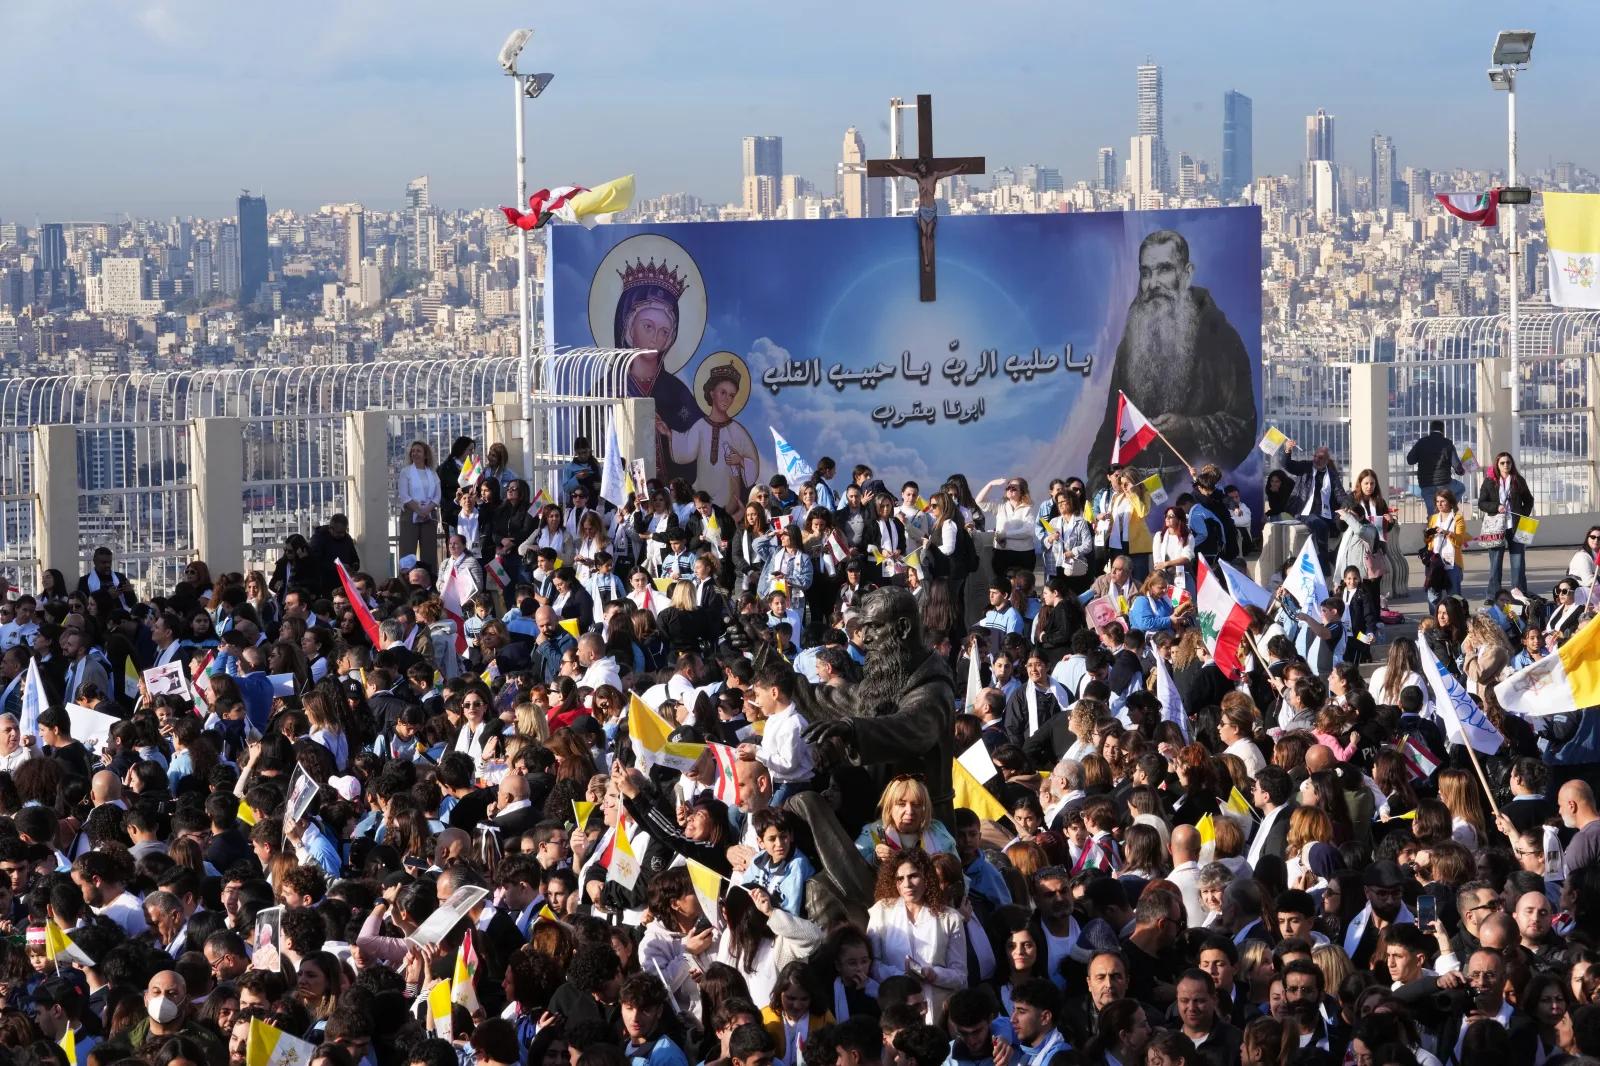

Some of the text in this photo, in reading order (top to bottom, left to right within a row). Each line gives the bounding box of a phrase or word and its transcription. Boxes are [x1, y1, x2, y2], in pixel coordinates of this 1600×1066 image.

[763, 357, 820, 393] القلب
[902, 350, 931, 383] يا
[1004, 347, 1059, 381] صليب
[1065, 343, 1092, 375] يا
[828, 362, 897, 390] حبيب
[872, 396, 985, 429] ابونا يعقوب
